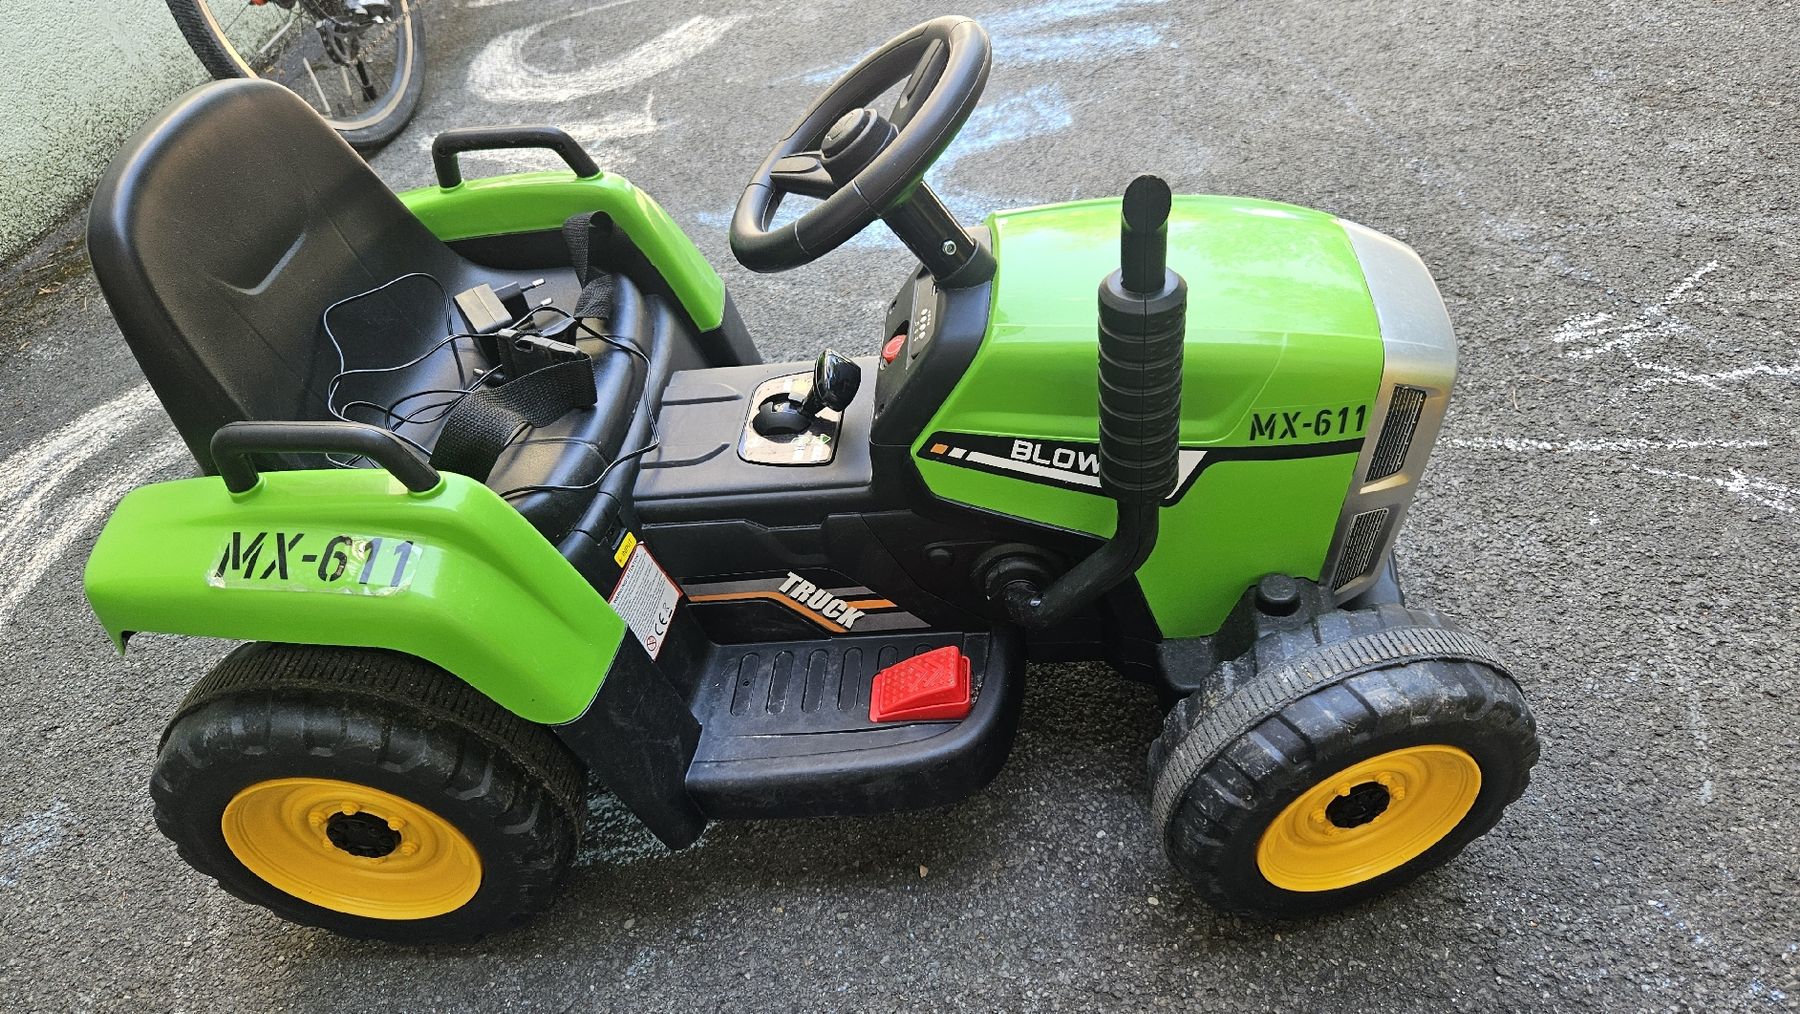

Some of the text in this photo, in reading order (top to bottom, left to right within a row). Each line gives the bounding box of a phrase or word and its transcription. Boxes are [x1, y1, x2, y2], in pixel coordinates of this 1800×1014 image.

[1249, 404, 1366, 440] MX-611
[214, 531, 414, 588] MX-611
[778, 571, 866, 629] TRUCK
